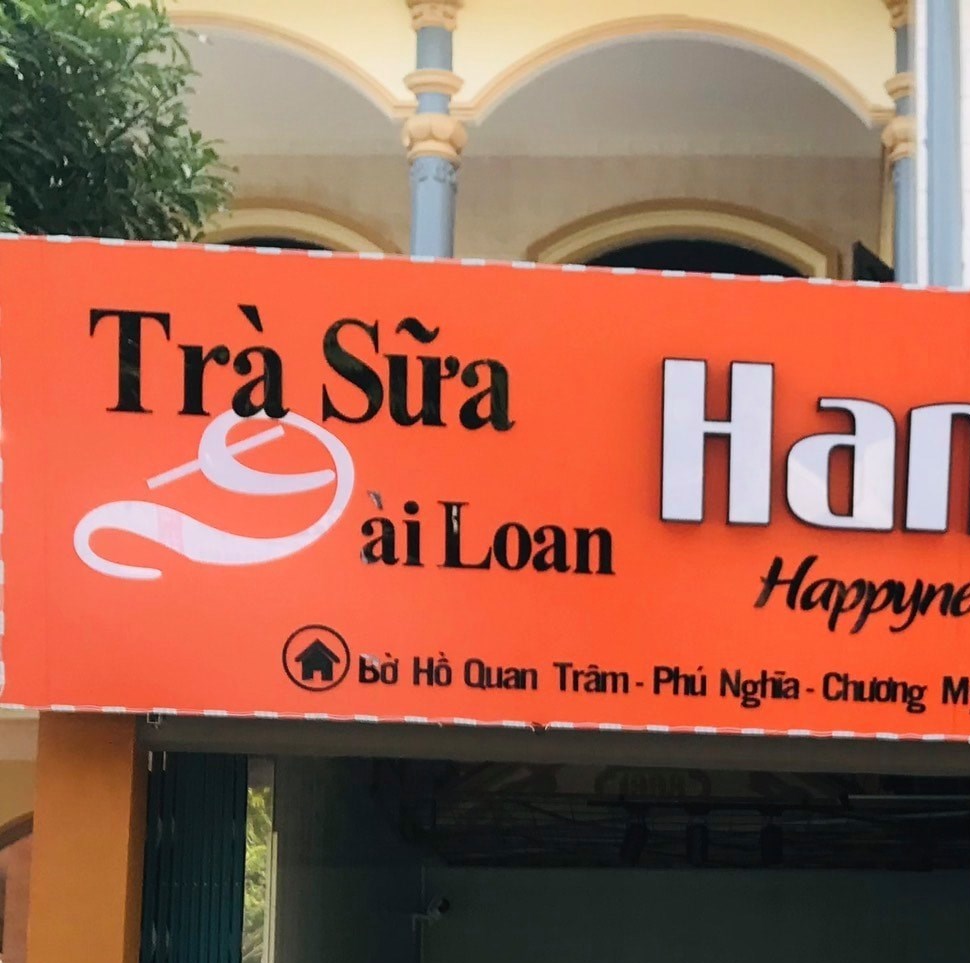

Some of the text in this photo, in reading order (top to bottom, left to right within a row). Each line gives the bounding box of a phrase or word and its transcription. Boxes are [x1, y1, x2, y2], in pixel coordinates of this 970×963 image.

[89, 305, 515, 432] Trà Sữa
[437, 500, 616, 575] Loan
[358, 652, 399, 685] Bờ
[413, 651, 453, 686] Hồ
[463, 657, 538, 690] Quan
[553, 662, 629, 694] Trâm
[653, 665, 707, 696] Phú
[719, 668, 800, 709] Nghĩa
